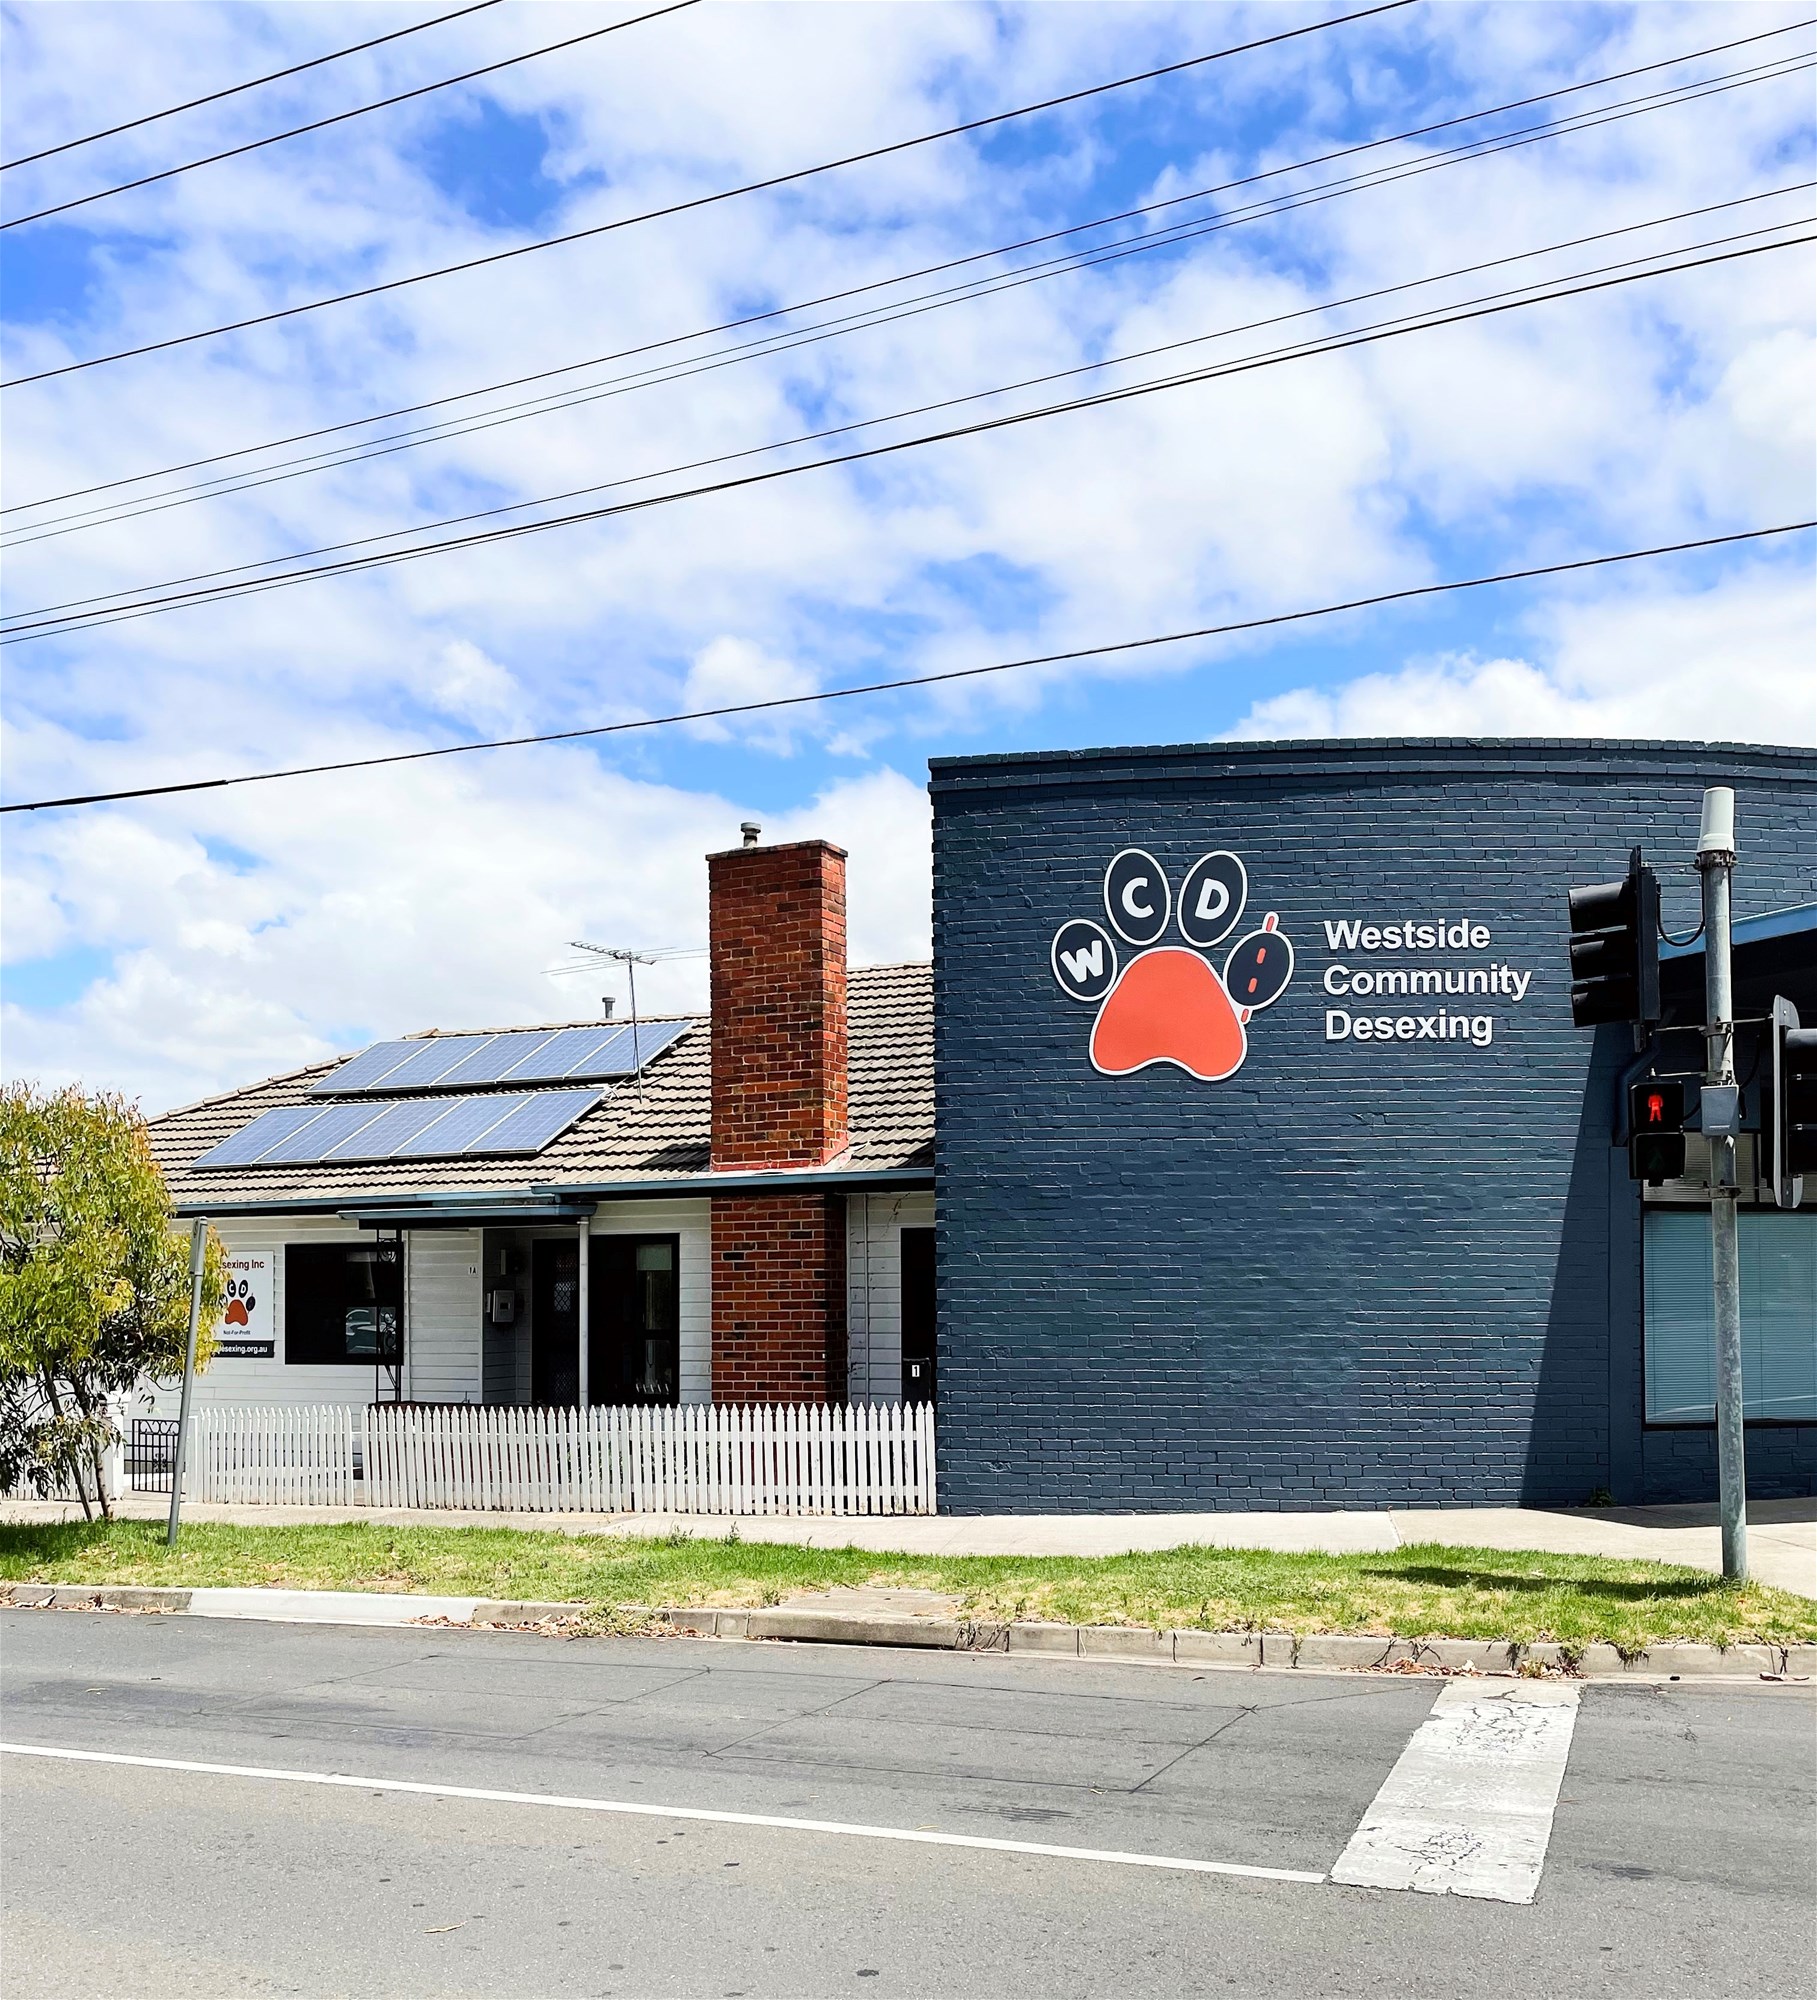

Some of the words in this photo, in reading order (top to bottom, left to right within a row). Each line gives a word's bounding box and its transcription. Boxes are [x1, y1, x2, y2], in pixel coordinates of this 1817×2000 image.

[1322, 918, 1491, 951] Westside
[1322, 963, 1532, 1001] Community
[1325, 1008, 1494, 1047] Desexing
[221, 1259, 250, 1271] sexing
[251, 1259, 265, 1269] Inc
